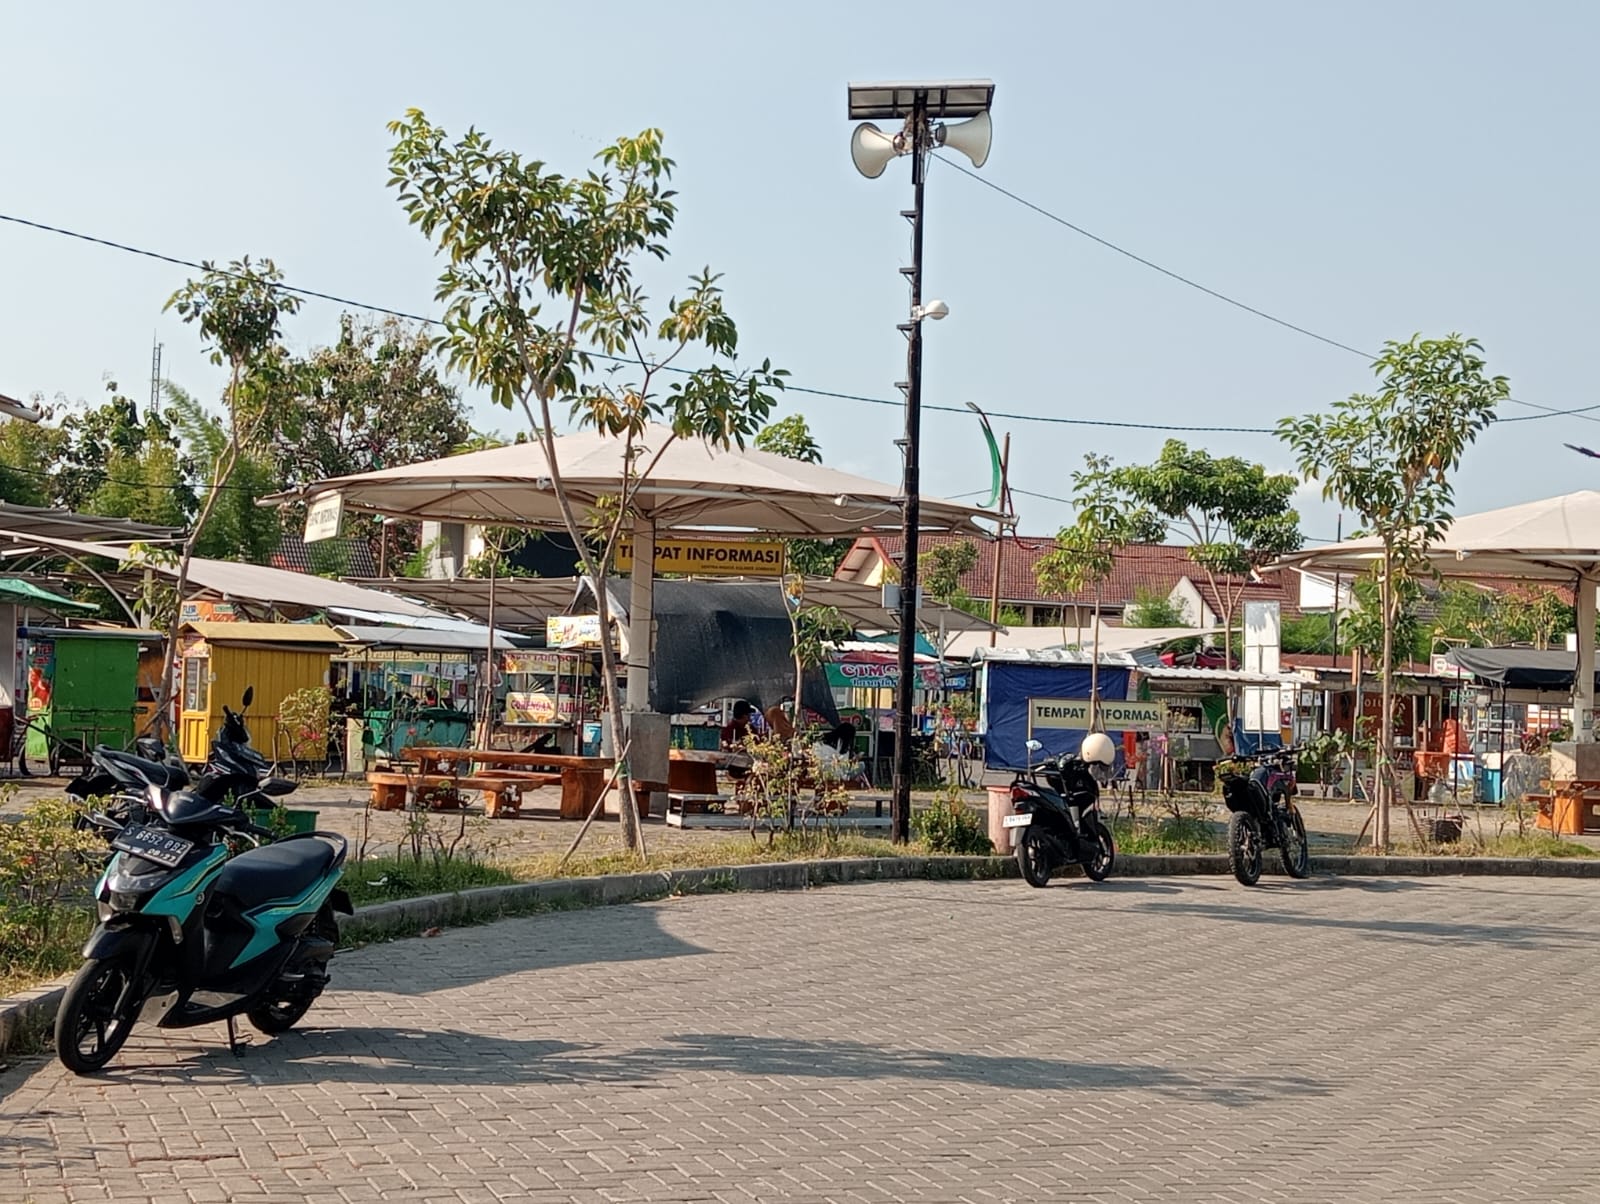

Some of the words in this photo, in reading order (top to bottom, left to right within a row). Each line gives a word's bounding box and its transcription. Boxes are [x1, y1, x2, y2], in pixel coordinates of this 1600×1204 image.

[619, 544, 682, 560] TPAT
[686, 547, 780, 563] INFORMASI
[1036, 706, 1086, 719] TEMPAT
[125, 826, 135, 836] S
[136, 830, 163, 846] 6652
